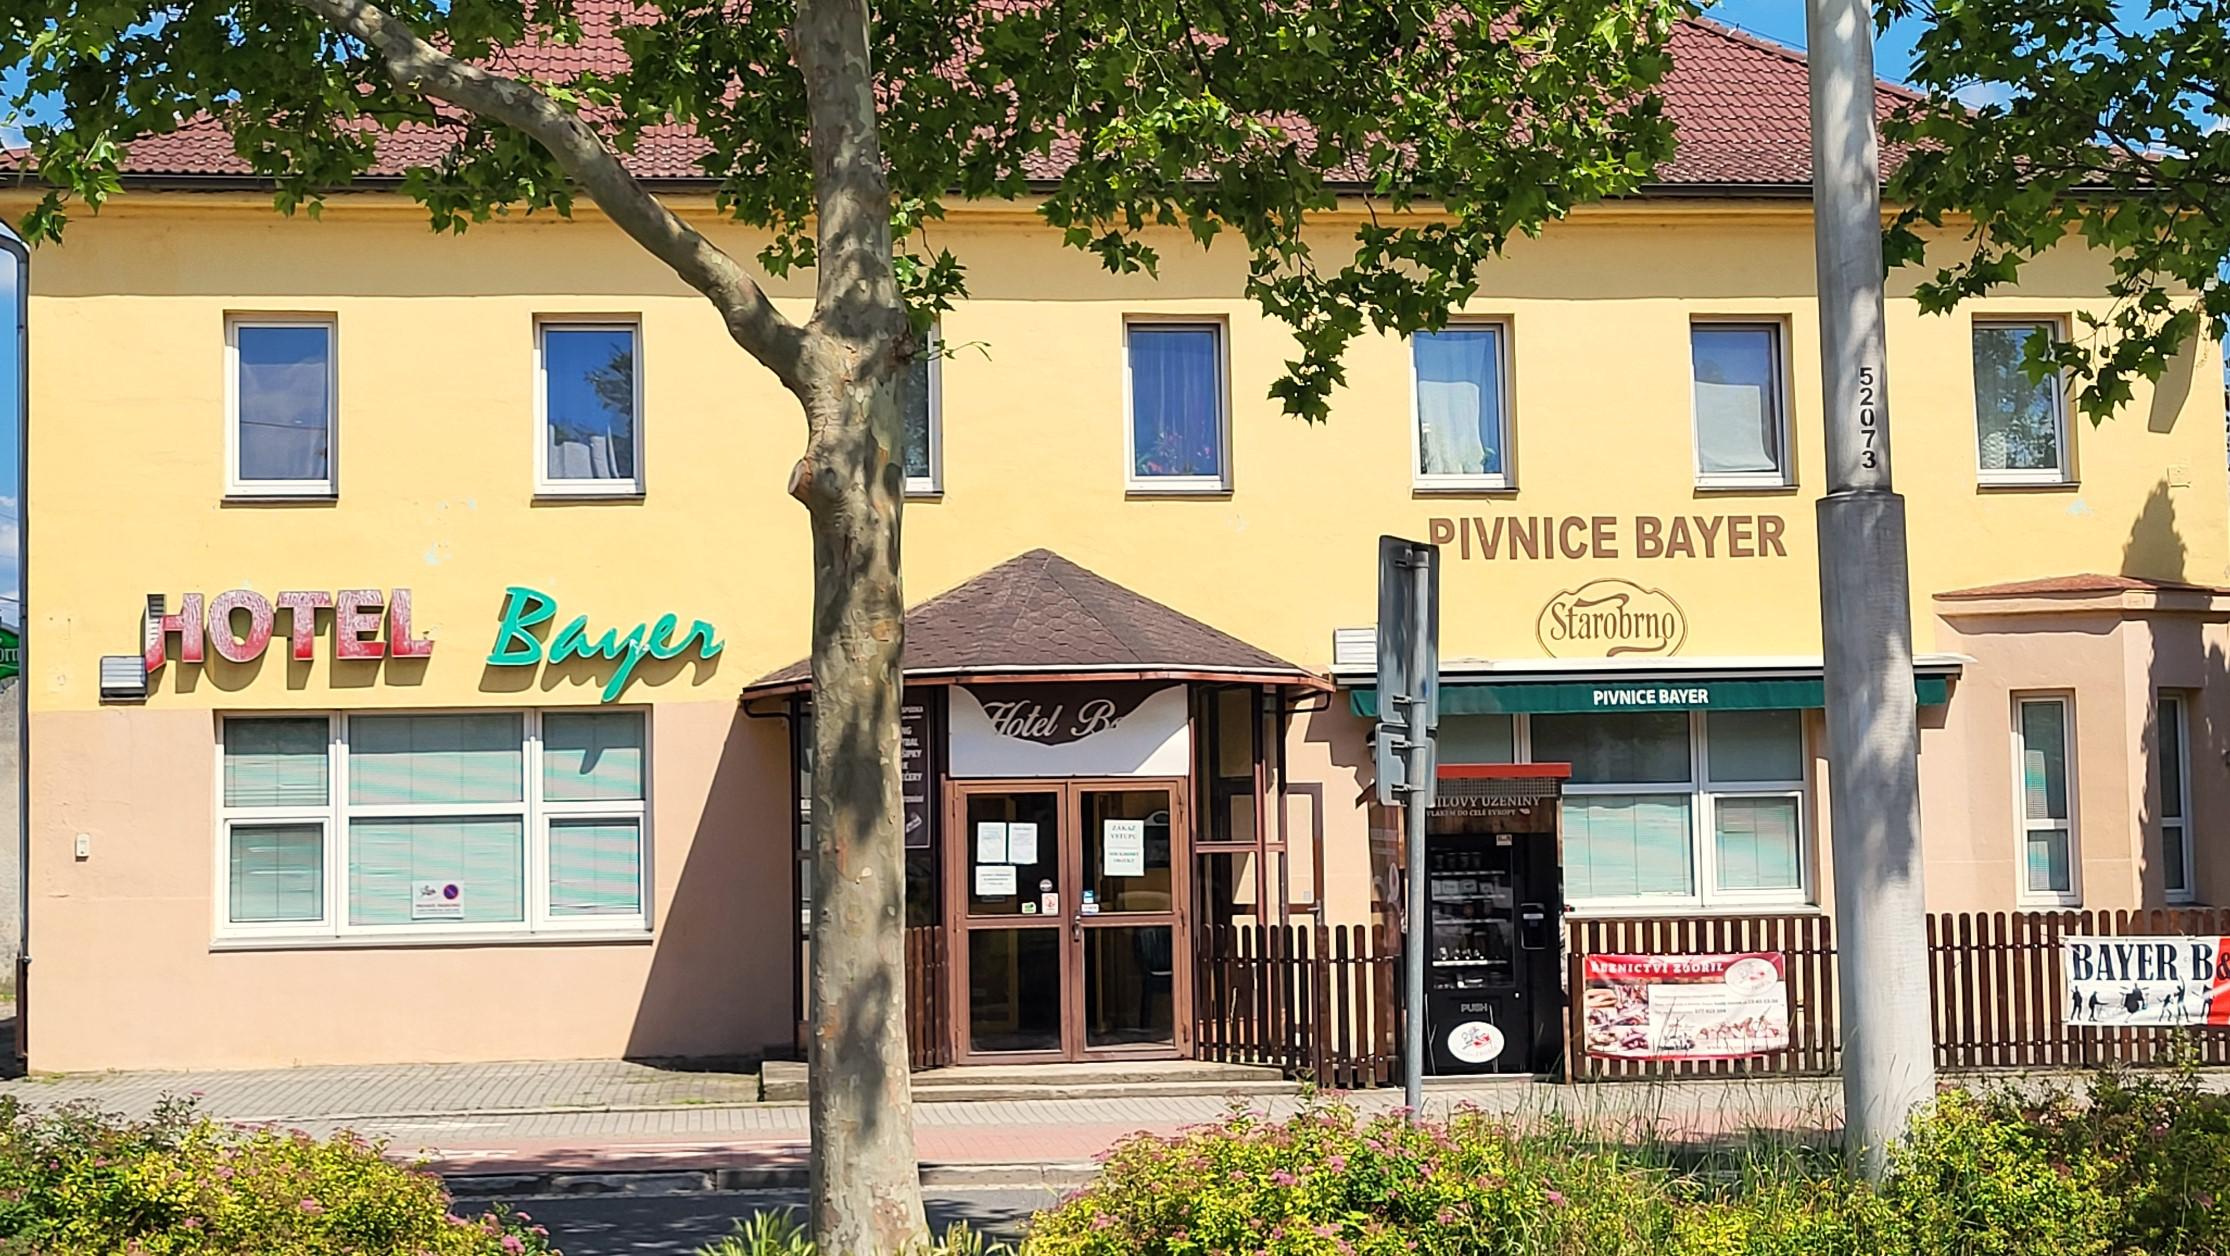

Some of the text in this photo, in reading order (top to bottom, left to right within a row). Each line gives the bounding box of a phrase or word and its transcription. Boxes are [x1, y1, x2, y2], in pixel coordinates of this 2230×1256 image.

[1859, 366, 1877, 469] 52073
[1429, 515, 1788, 560] PIVNICE BAYER
[1550, 593, 1676, 650] Starobrno
[145, 586, 725, 703] HOTEL Bayer
[1593, 688, 1709, 706] PIVNICE BAYER
[983, 700, 1064, 737] Hotel
[2070, 943, 2178, 981] BAYER
[1460, 1003, 1488, 1013] PUSH
